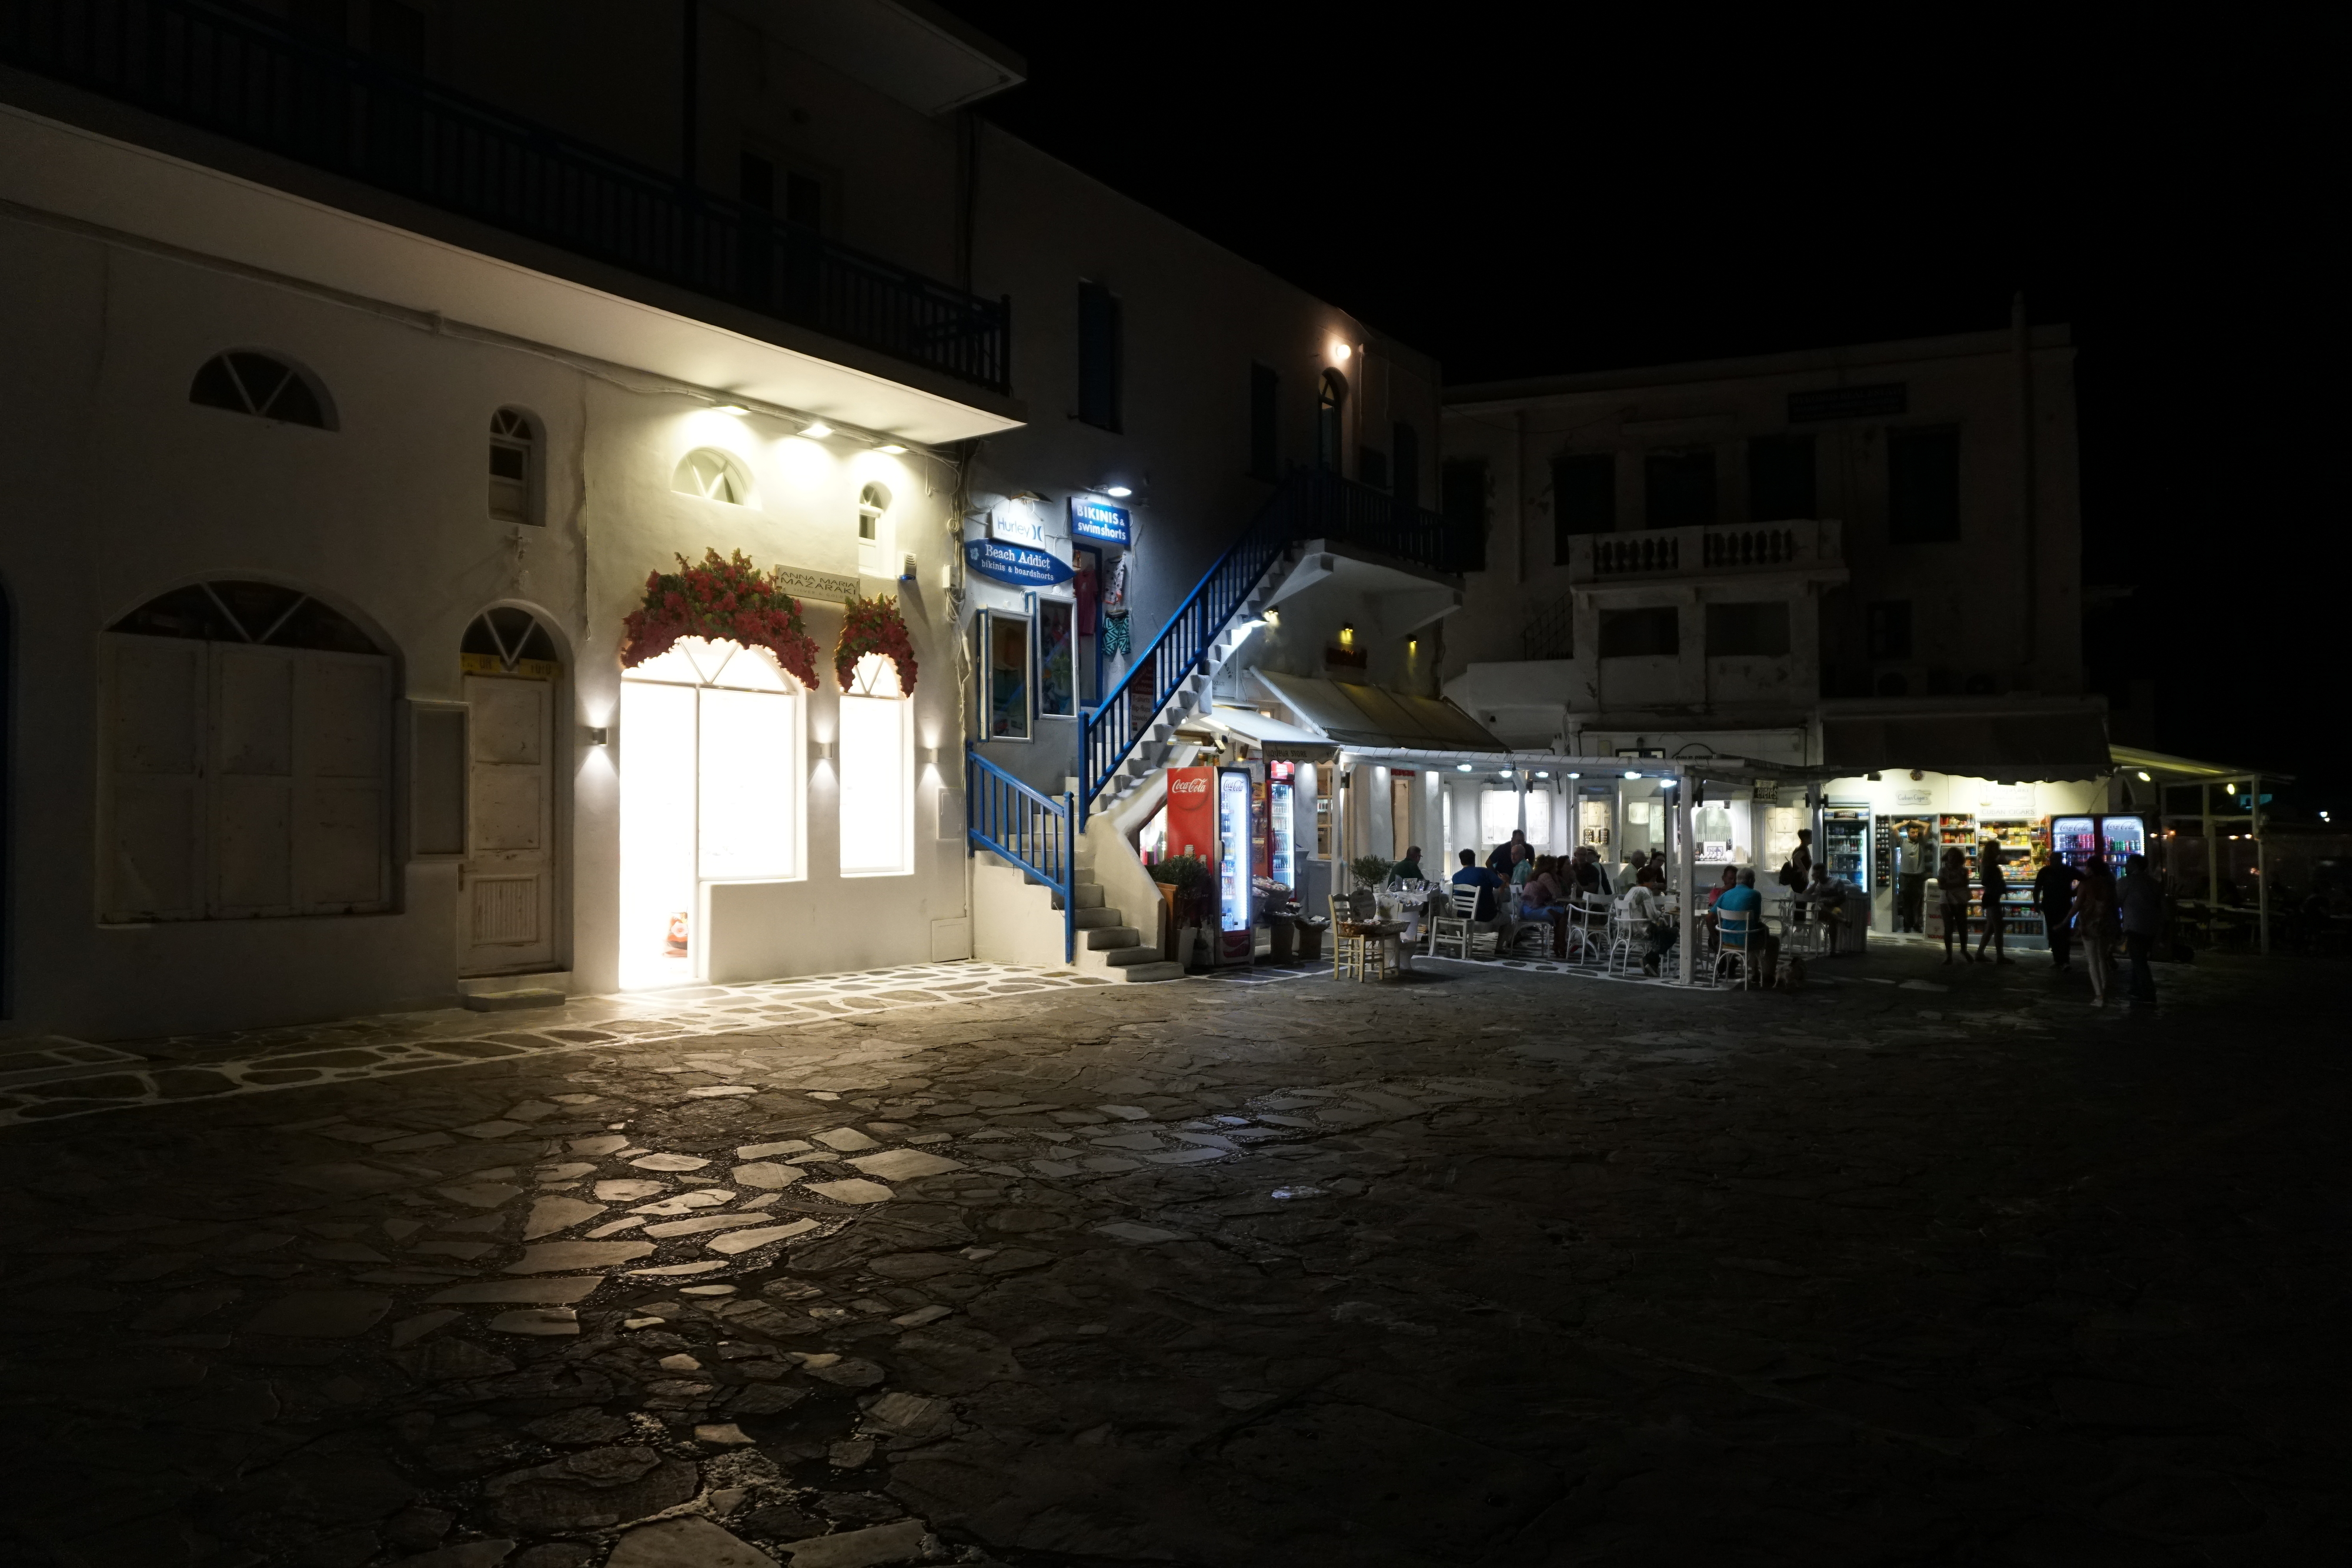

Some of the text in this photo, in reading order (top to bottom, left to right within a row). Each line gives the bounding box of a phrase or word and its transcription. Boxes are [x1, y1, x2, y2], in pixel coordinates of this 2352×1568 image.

[1077, 504, 1118, 524] BIKINIS
[997, 516, 1030, 537] Hurley
[985, 544, 1050, 569] Beach Addict
[981, 560, 1005, 572] bikinis
[1014, 566, 1054, 581] boardshorts
[780, 577, 856, 595] MAZARAKI
[781, 571, 856, 589] ANNA MARIA
[1132, 695, 1150, 703] T-shirts
[1291, 750, 1308, 758] STORE
[1172, 778, 1208, 793] Coca-Cola
[1758, 787, 1778, 799] everes
[1913, 794, 1928, 802] Cigars
